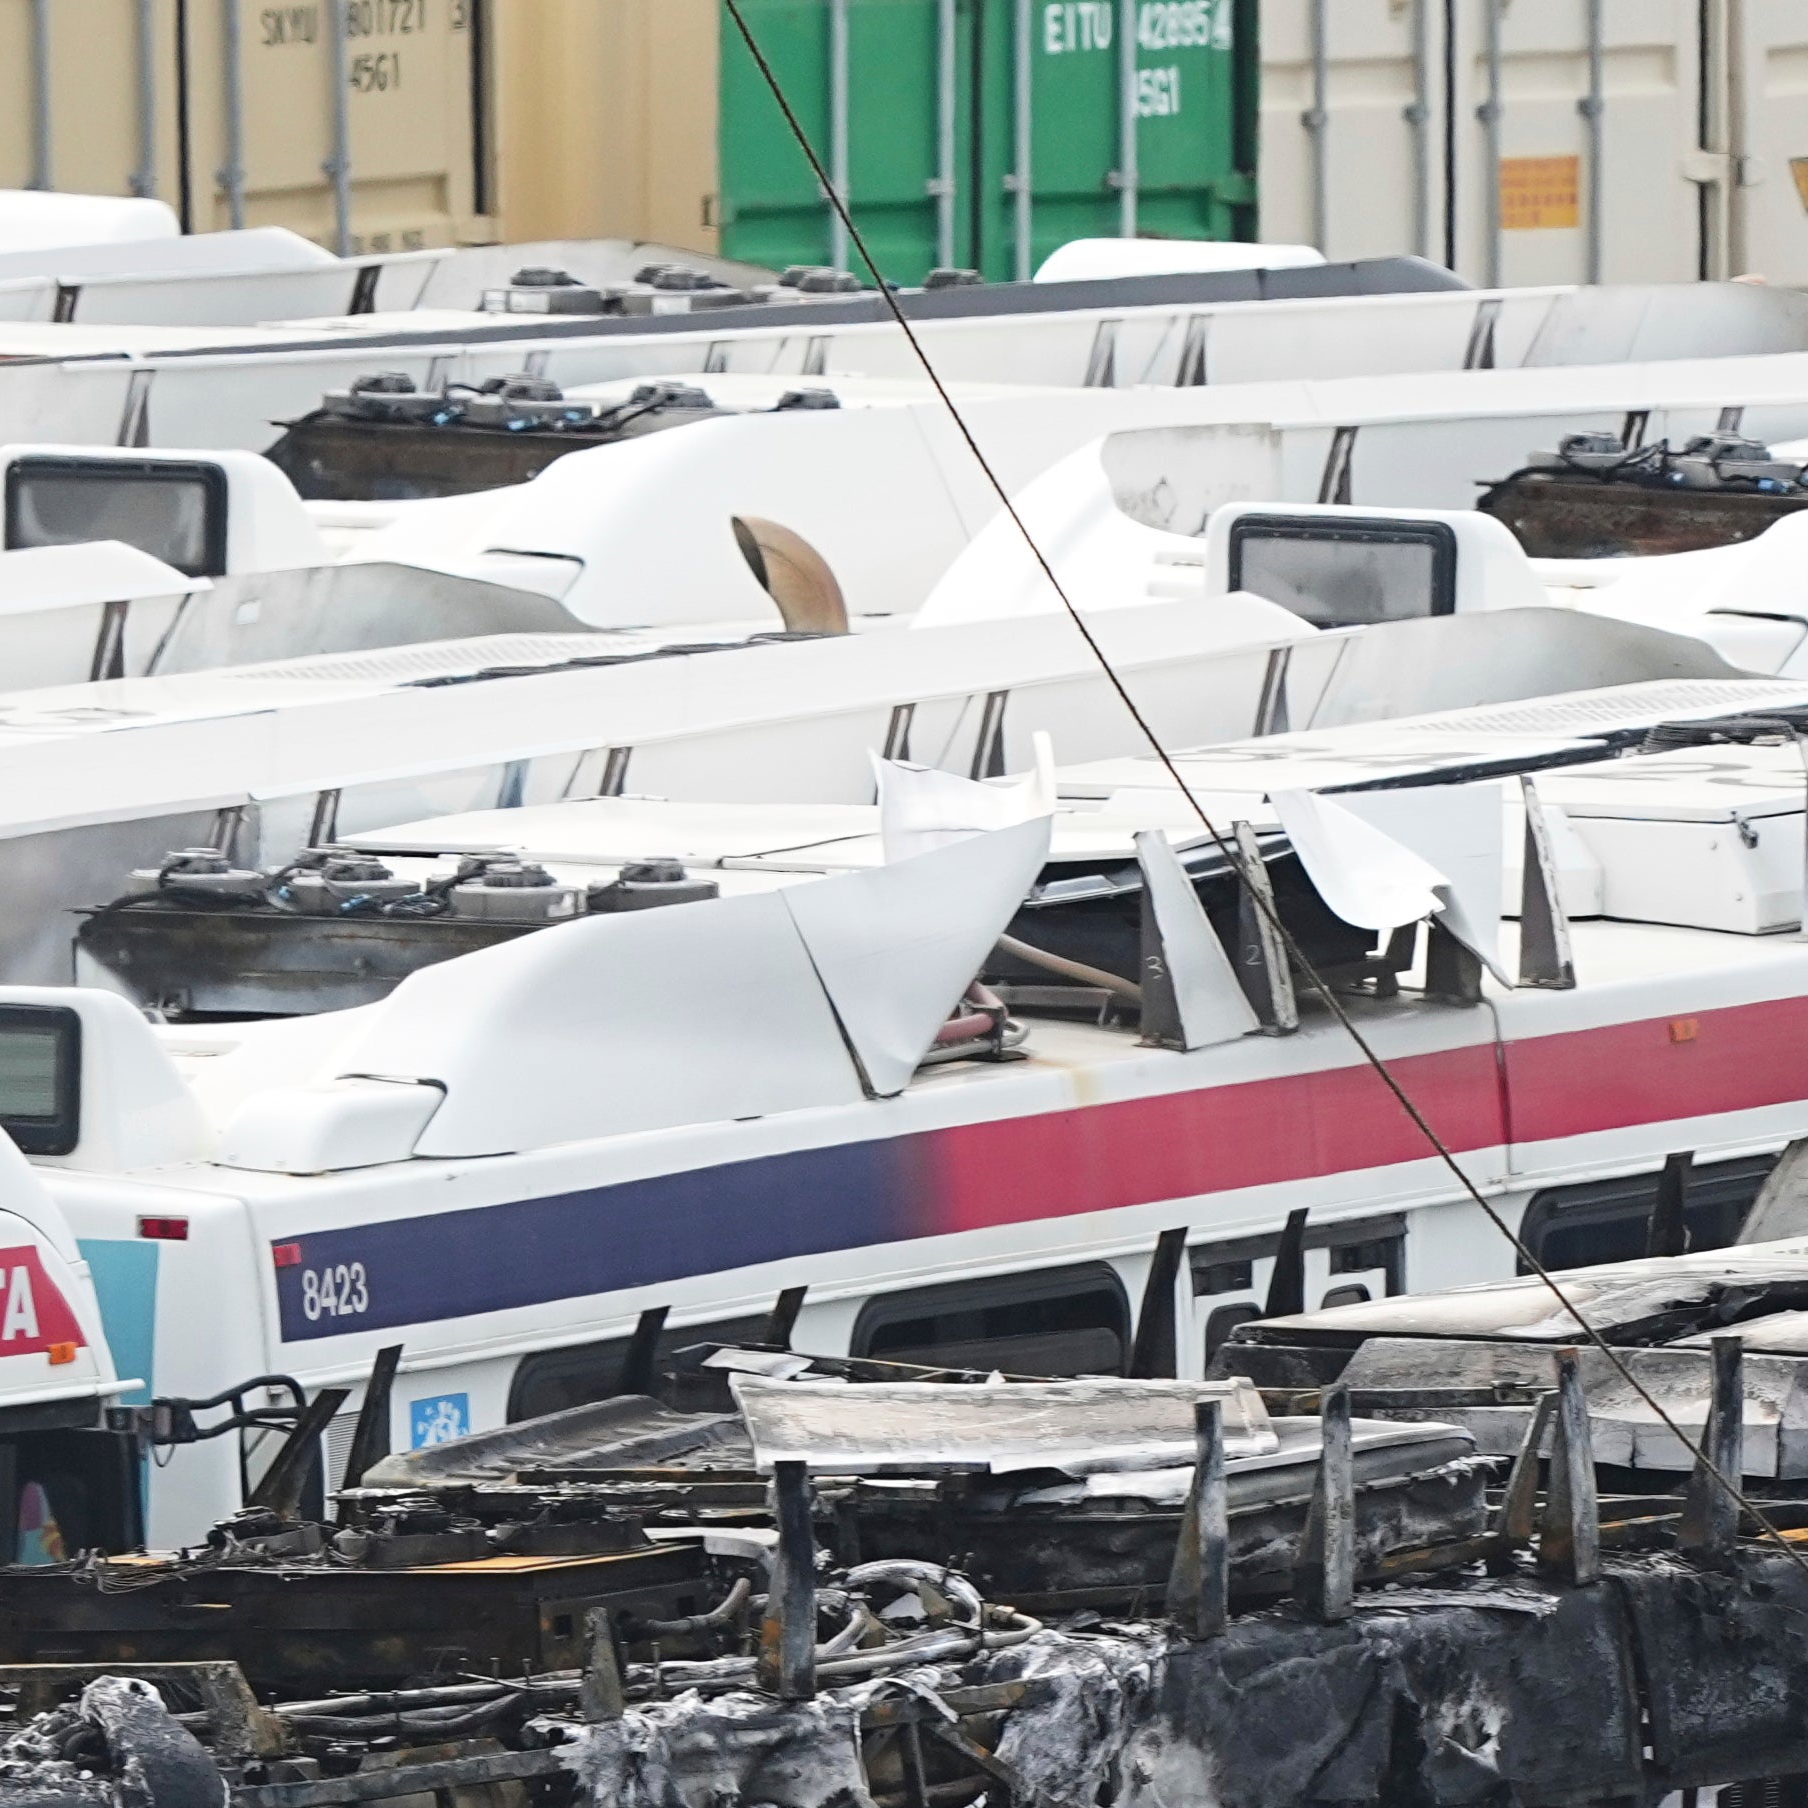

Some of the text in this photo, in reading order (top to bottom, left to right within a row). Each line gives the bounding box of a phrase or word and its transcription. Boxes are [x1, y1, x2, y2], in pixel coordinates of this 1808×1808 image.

[1045, 3, 1113, 54] EITU
[1136, 0, 1211, 49] 42895
[1133, 66, 1179, 116] 5G1
[1246, 943, 1263, 966] 2
[302, 1262, 370, 1321] 8423
